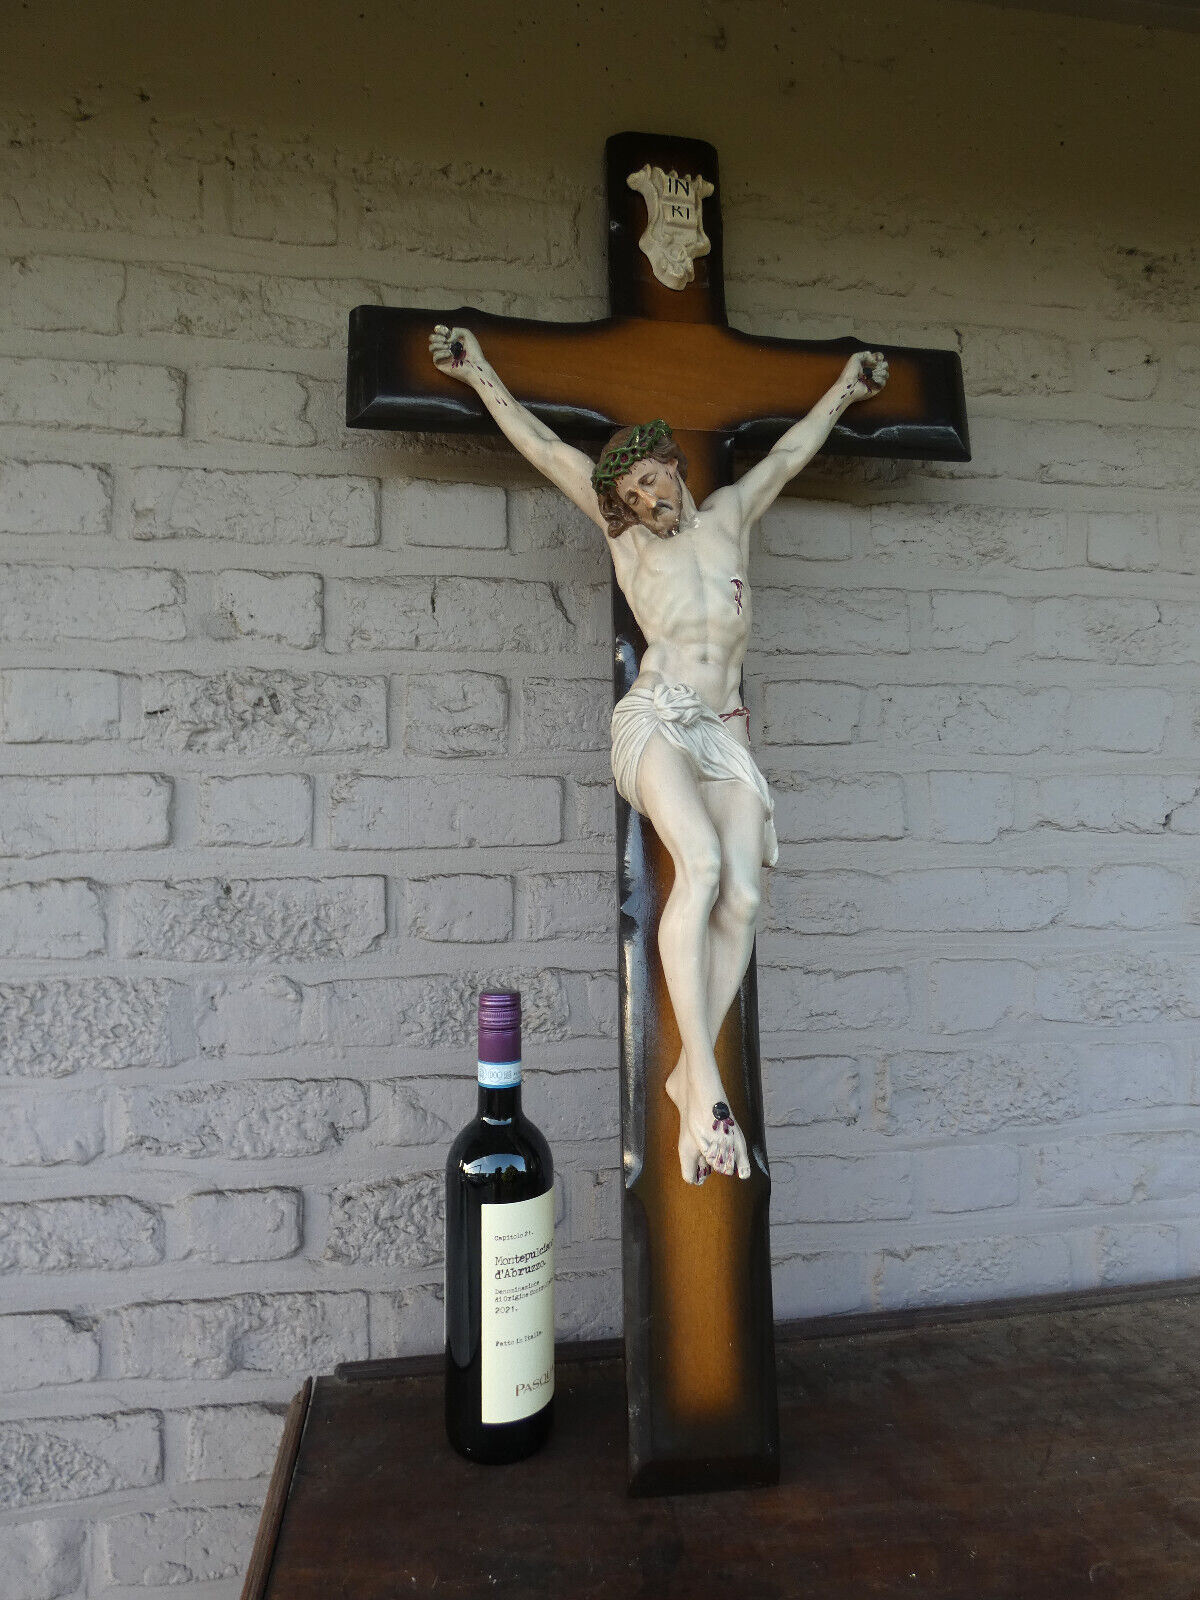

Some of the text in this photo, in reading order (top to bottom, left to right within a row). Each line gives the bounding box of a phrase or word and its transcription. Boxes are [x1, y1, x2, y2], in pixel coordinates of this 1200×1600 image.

[668, 177, 690, 197] IN
[494, 1233, 523, 1242] Capitolo
[504, 1293, 528, 1302] Origine
